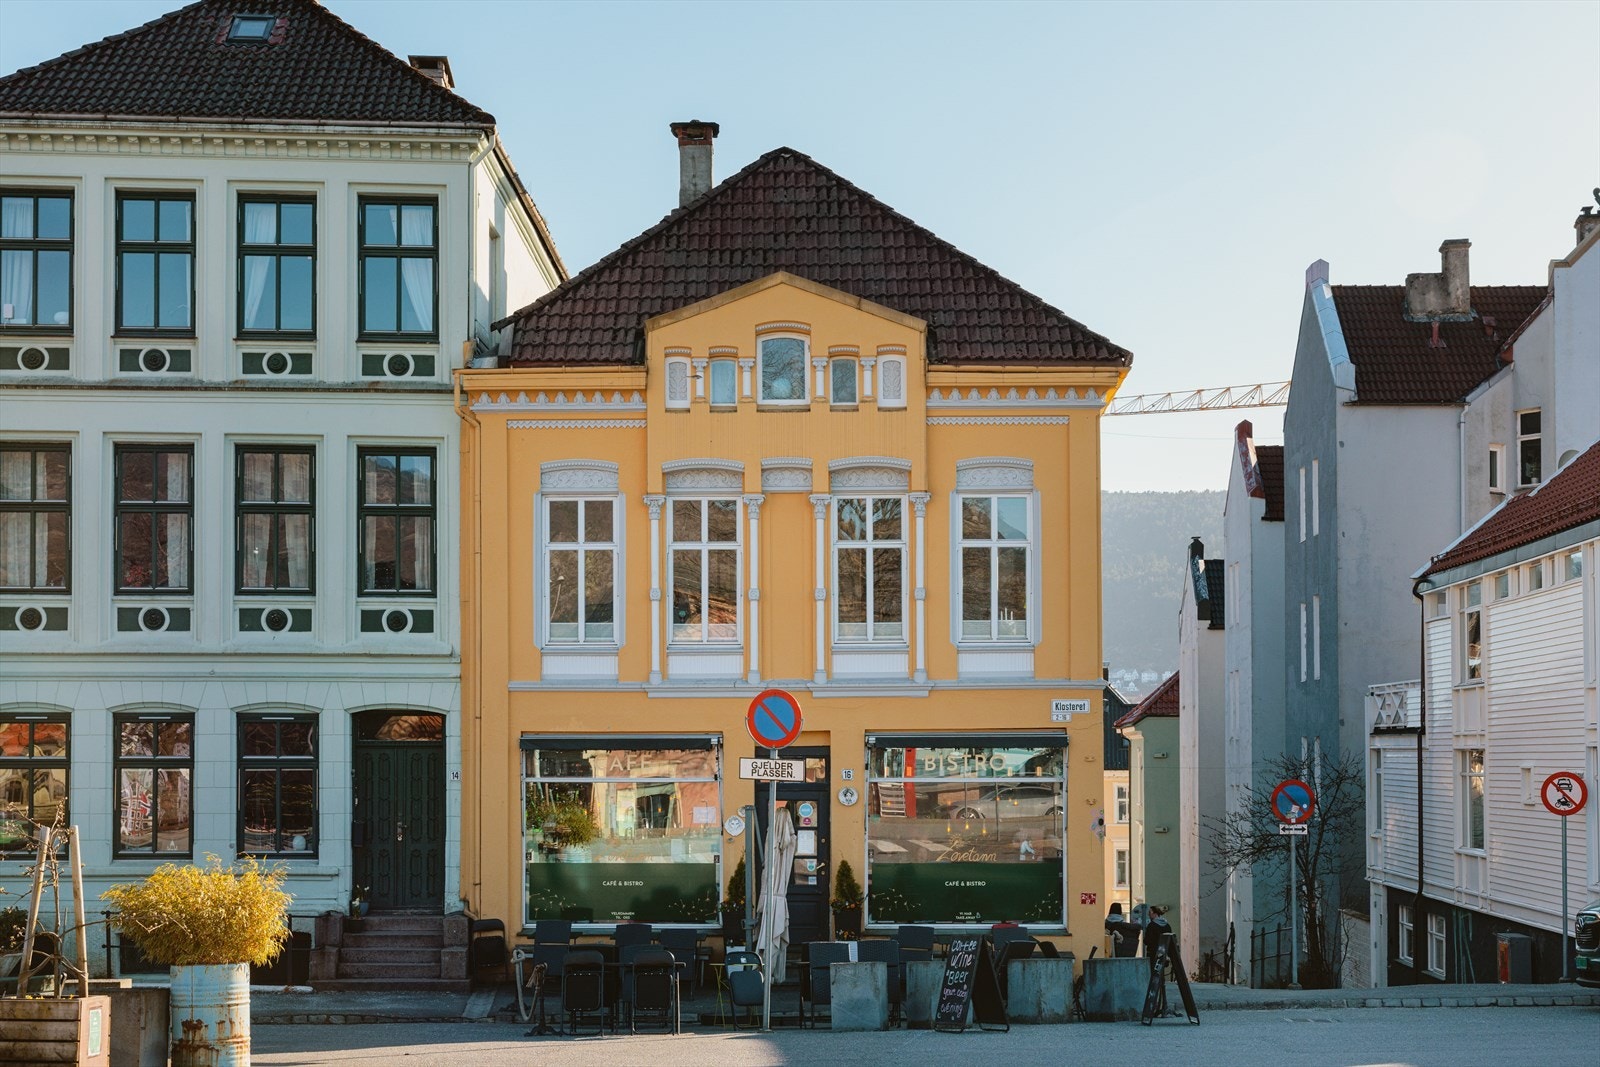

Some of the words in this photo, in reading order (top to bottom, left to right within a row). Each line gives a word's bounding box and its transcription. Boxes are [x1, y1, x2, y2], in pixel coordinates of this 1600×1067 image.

[1055, 702, 1086, 711] Klosteret
[751, 761, 794, 770] GJELDER
[924, 754, 1006, 771] BISTRO
[451, 771, 459, 780] 14
[844, 770, 852, 778] 16
